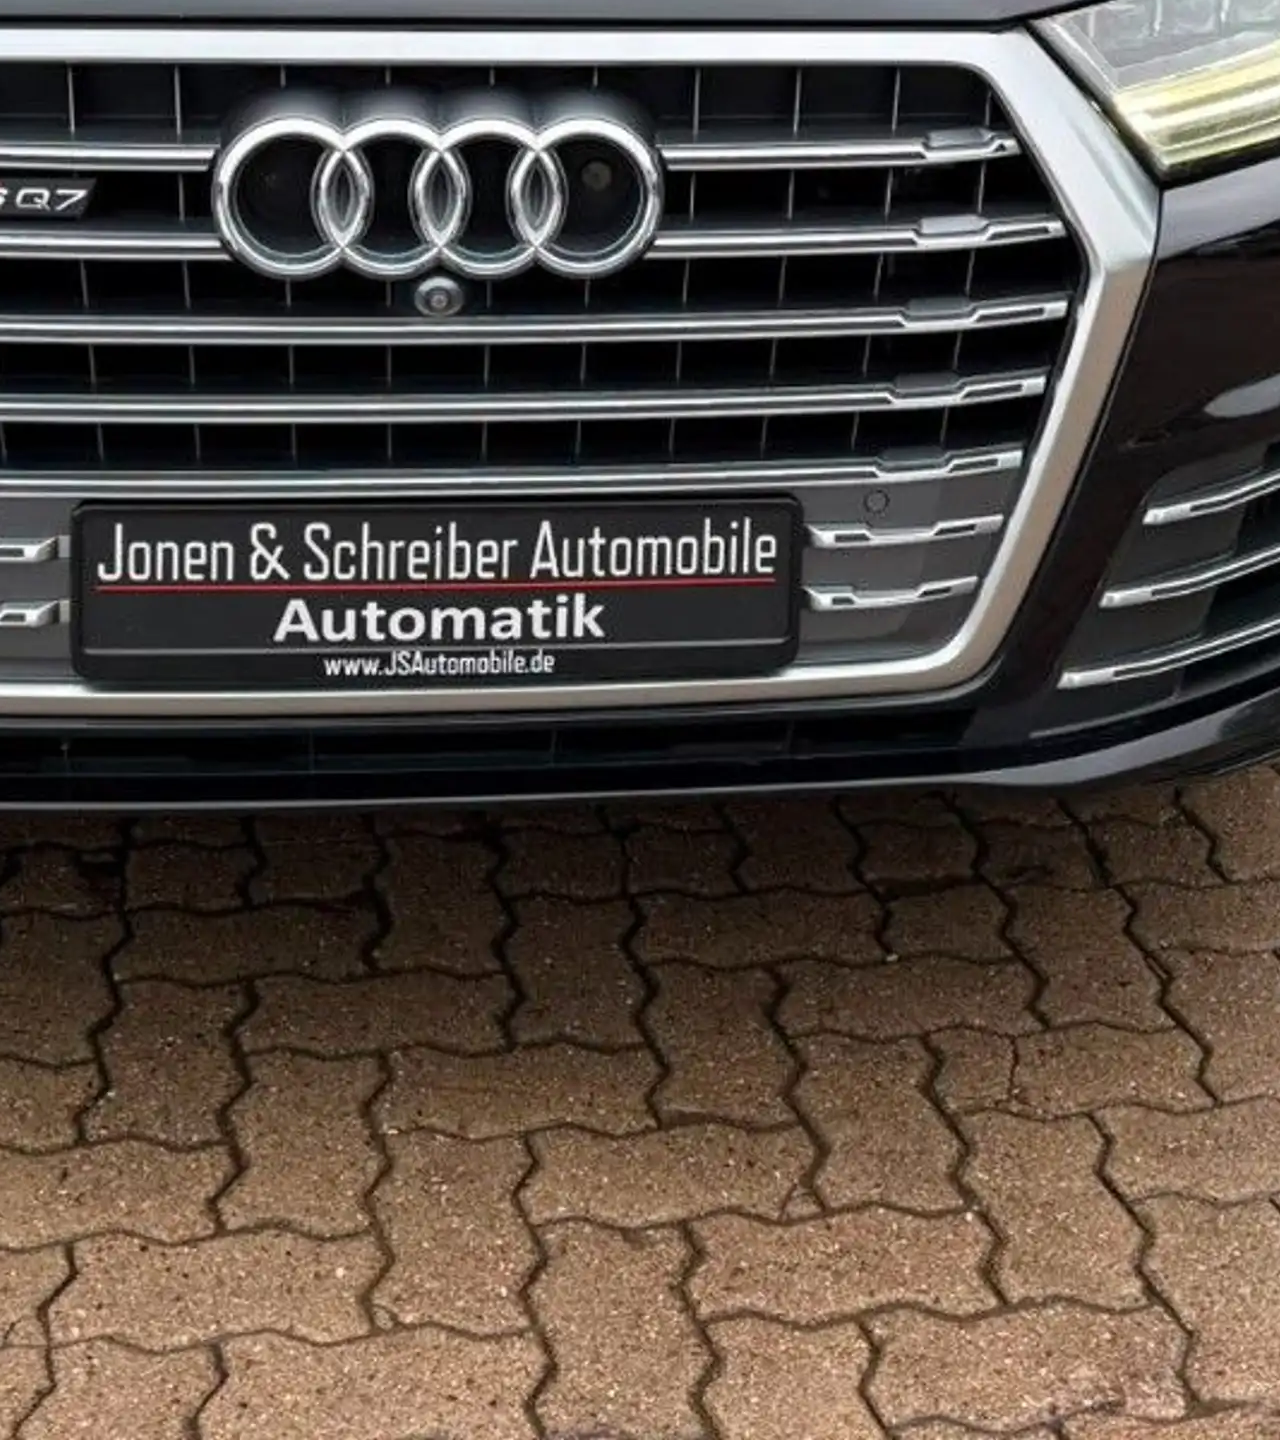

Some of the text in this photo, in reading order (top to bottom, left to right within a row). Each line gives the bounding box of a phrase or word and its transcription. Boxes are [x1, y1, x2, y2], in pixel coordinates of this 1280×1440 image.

[97, 517, 777, 582] Jonen & Schreiber Automobile
[273, 592, 605, 642] Automatik
[324, 647, 555, 676] www.JSAutomobile.de
